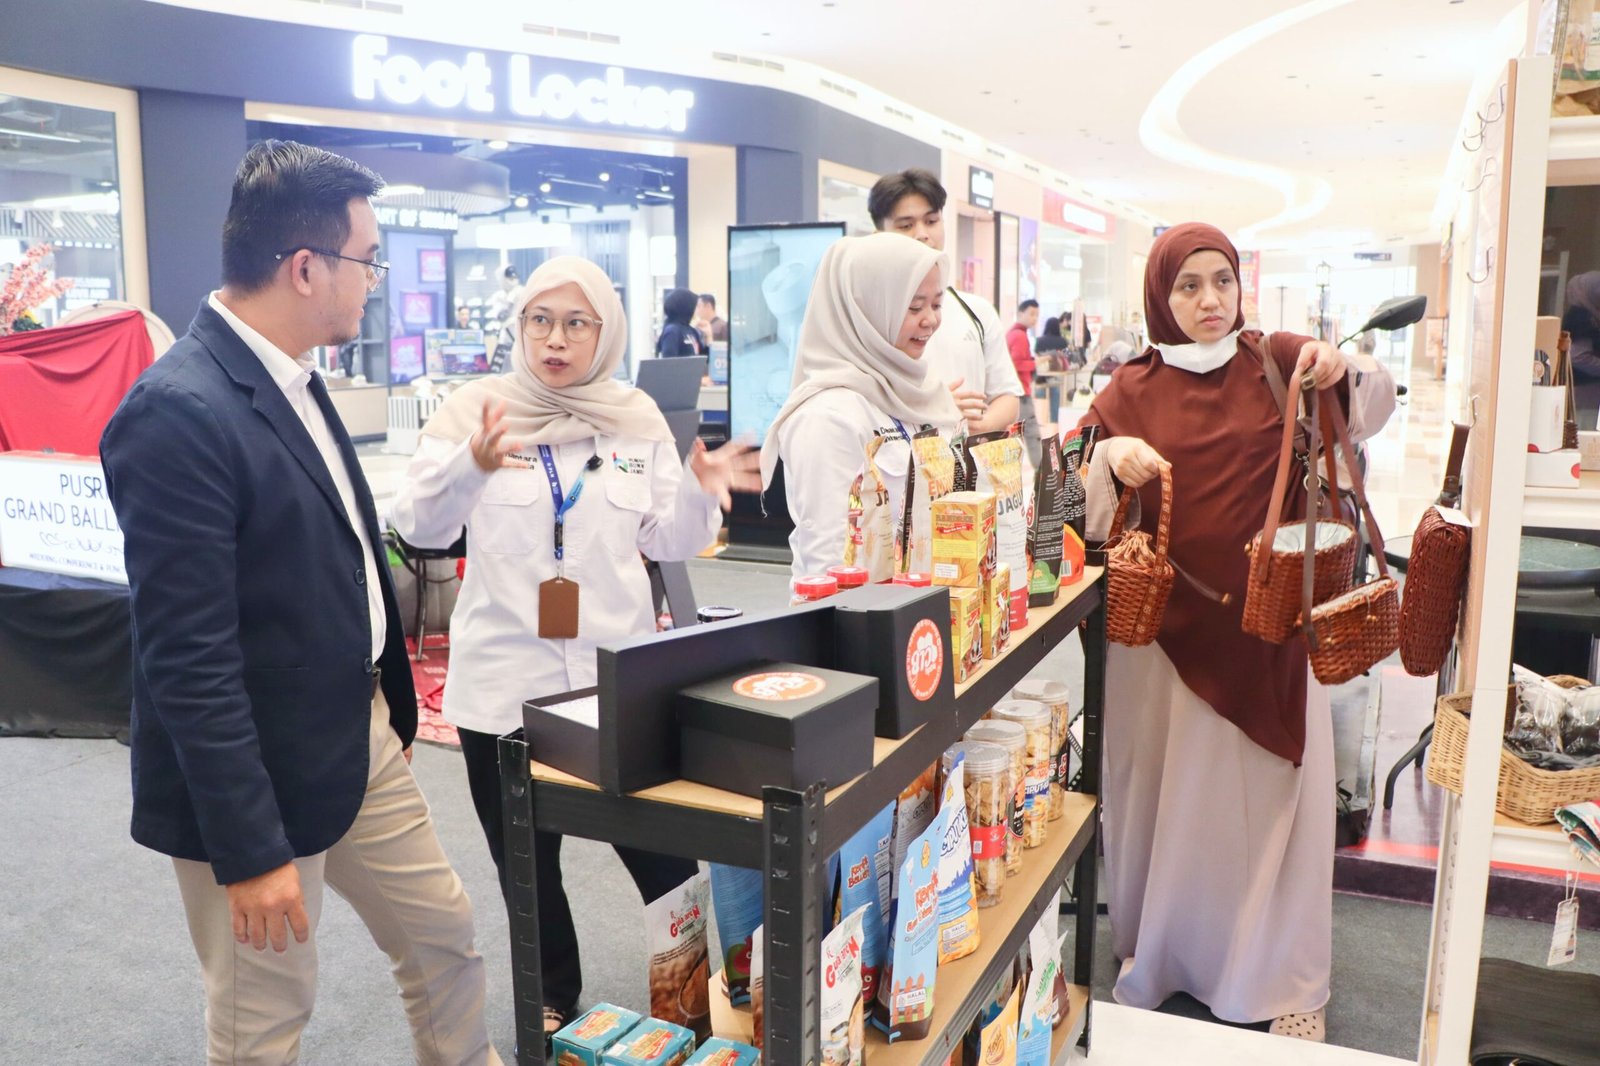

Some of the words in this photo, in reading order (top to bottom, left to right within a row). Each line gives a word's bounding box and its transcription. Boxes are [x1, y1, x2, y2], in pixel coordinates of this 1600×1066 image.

[353, 34, 495, 113] Foot
[510, 53, 694, 132] Locker
[4, 497, 66, 525] GRAND
